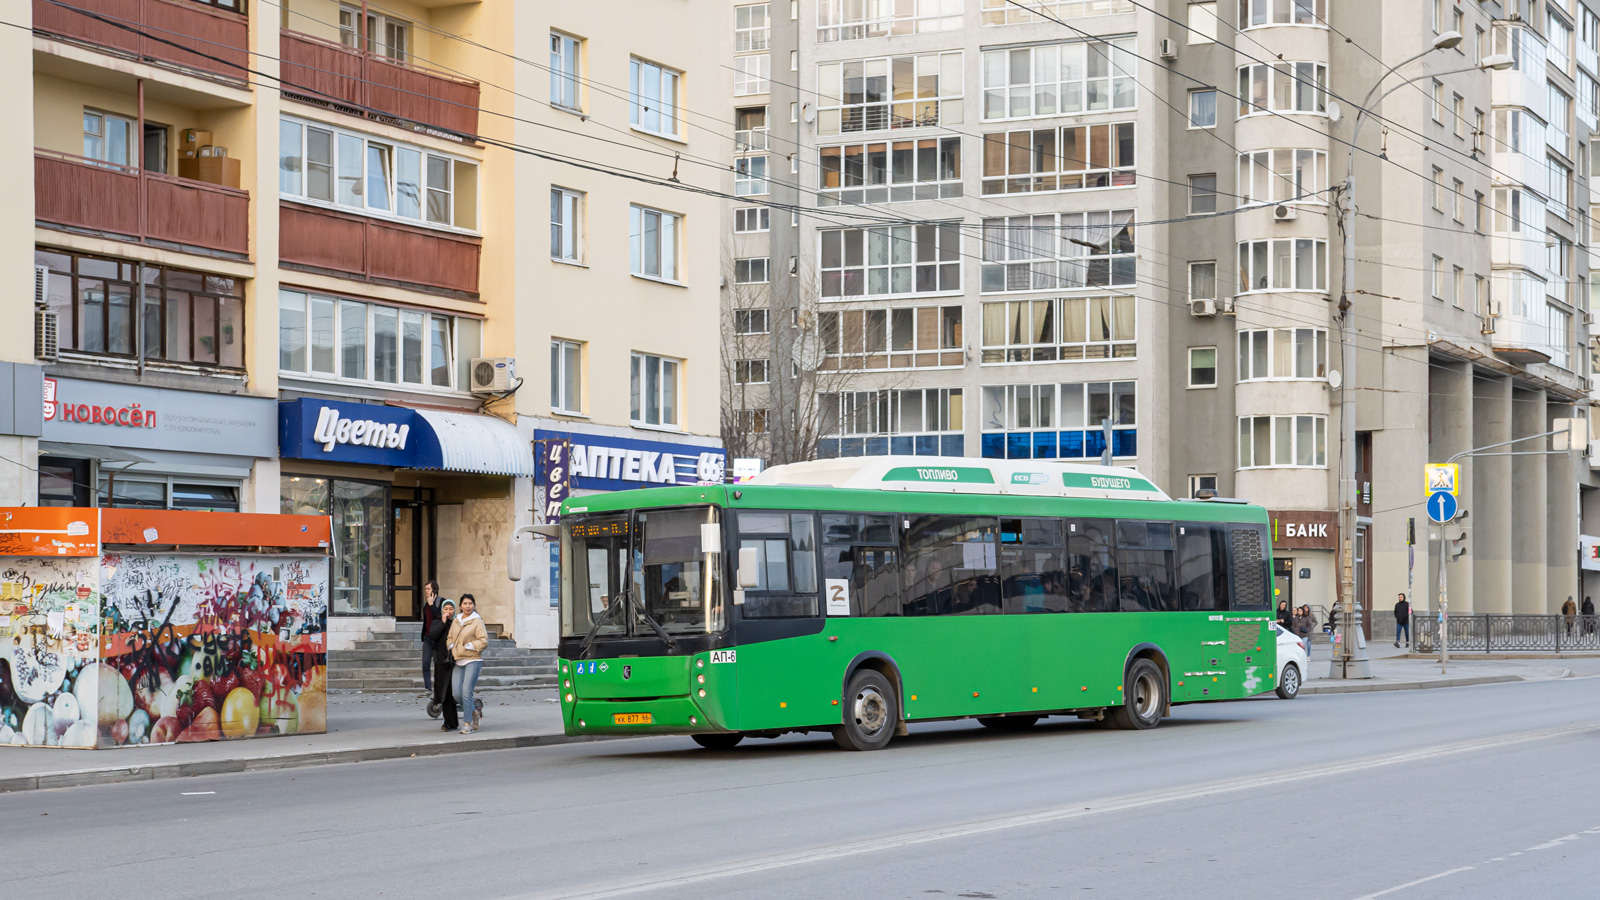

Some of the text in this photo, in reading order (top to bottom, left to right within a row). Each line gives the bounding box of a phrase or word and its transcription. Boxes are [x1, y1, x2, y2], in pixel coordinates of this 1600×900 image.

[314, 406, 410, 452] Цветы
[570, 444, 677, 484] АПТЕКА
[697, 452, 721, 482] 66
[917, 468, 958, 481] ТОПЛИВО
[1090, 476, 1131, 489] БУДУЩЕГО
[1286, 523, 1328, 537] БАНК
[712, 651, 736, 662] АП-6
[628, 715, 639, 723] 877
